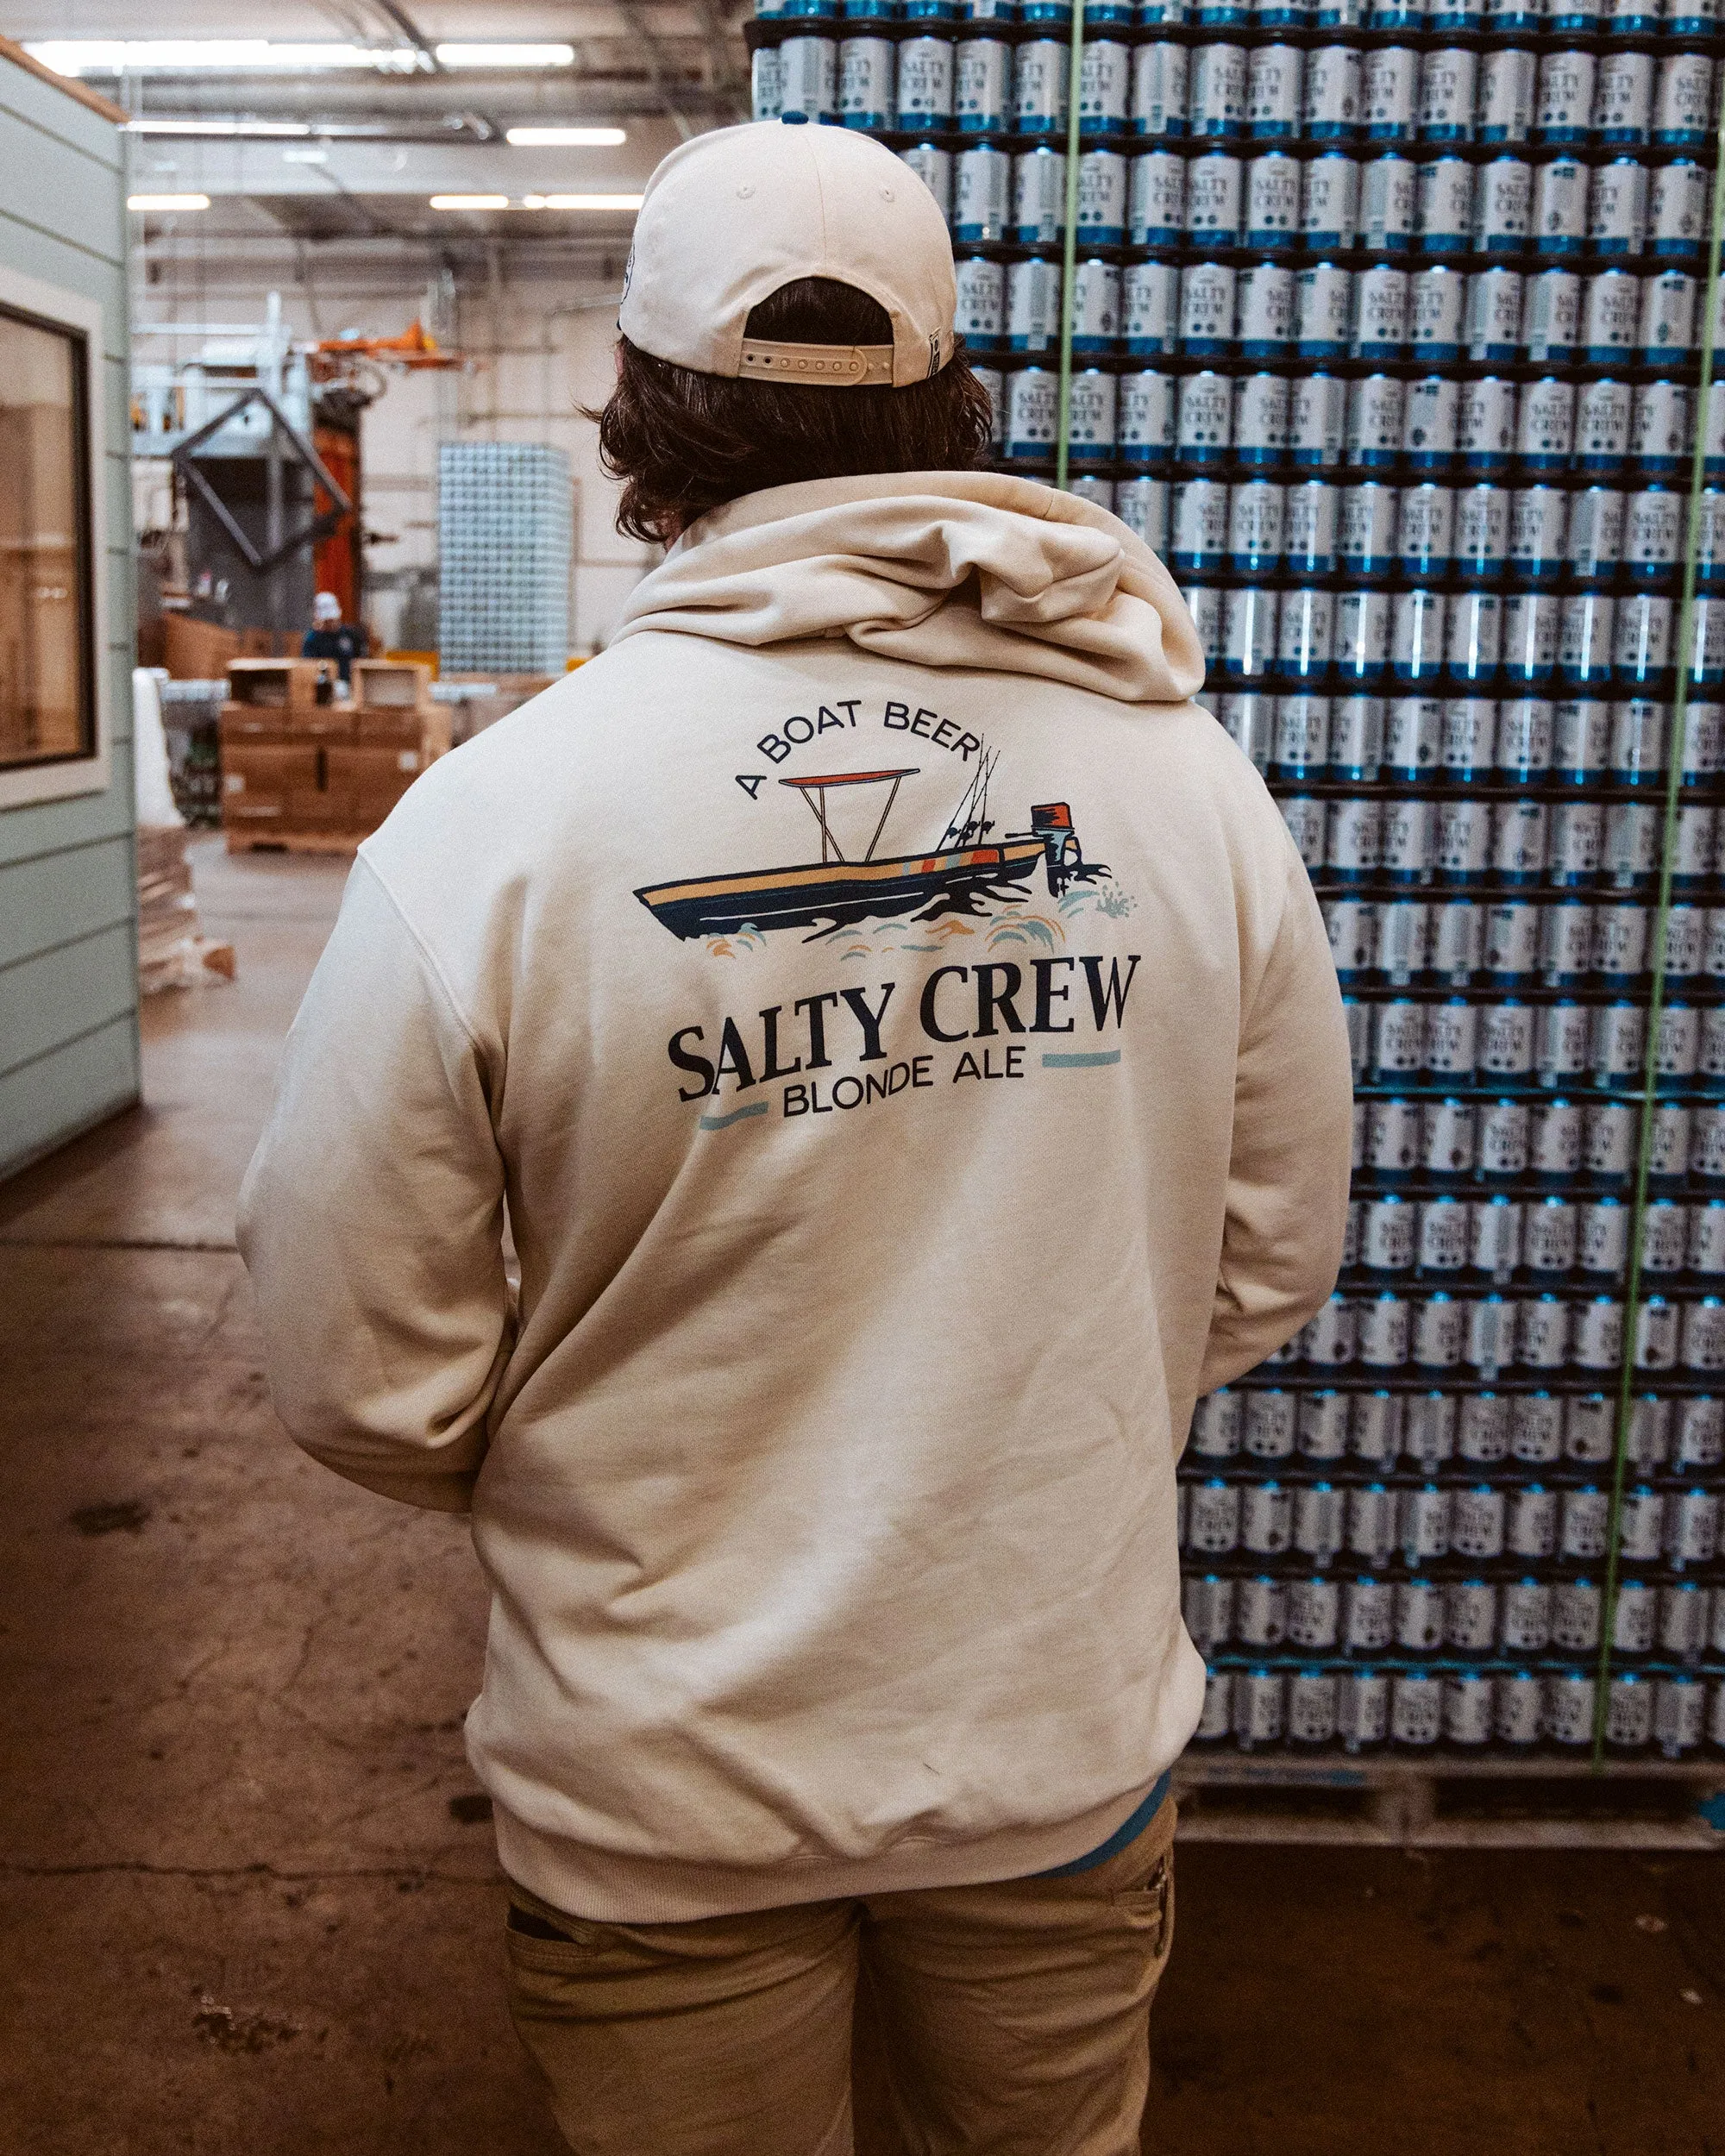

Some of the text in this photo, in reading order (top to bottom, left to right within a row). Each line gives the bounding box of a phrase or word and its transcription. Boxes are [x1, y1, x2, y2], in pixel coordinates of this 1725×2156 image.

[736, 699, 981, 799] A BOAT BEER
[667, 955, 1142, 1103] SALTY CREW
[783, 1046, 1026, 1119] BLONDE ALE
